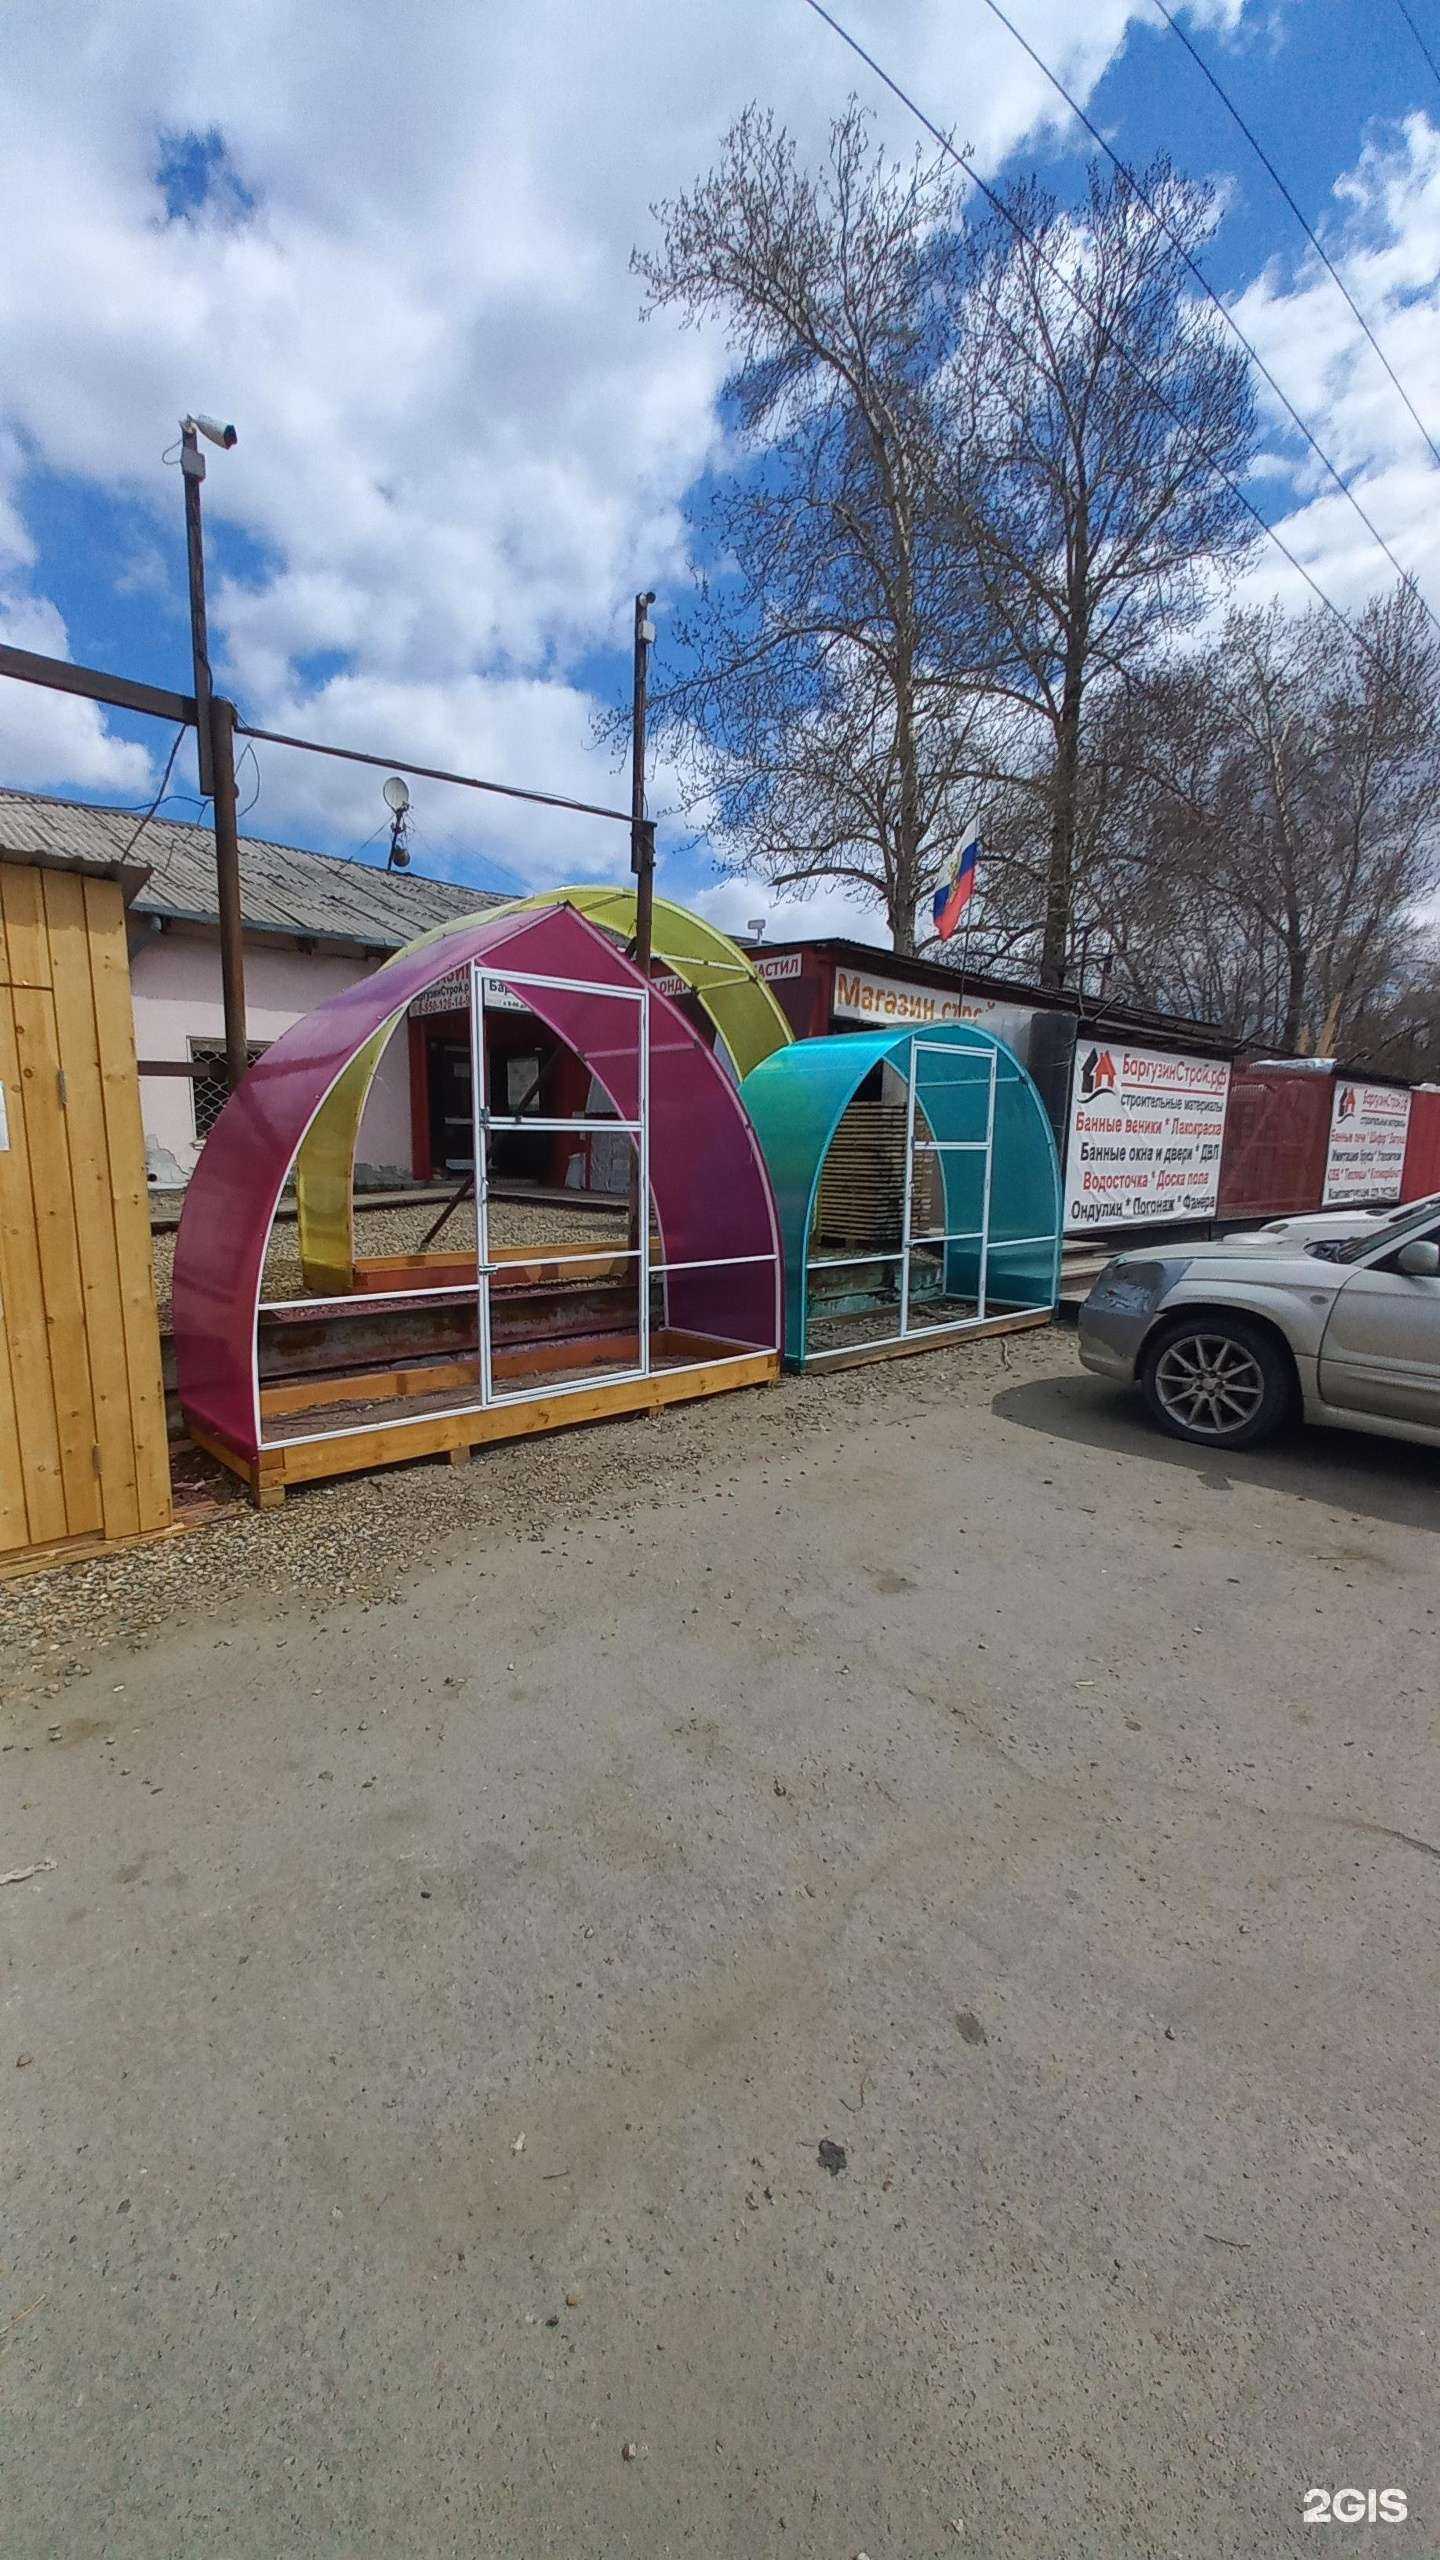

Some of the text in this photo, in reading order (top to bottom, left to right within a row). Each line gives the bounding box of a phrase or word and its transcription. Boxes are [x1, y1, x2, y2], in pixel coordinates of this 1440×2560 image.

[754, 958, 799, 977] АСТИЛ
[660, 979, 686, 994] ОНД
[838, 973, 935, 1020] Магазин
[1122, 1053, 1227, 1090] БаргузинСтрой.рф
[1120, 1093, 1183, 1110] строительные
[1076, 1112, 1222, 1138] Банные веники Лакокраска
[1080, 1142, 1126, 1161] Банные
[1129, 1146, 1154, 1161] окна
[1155, 1147, 1162, 1161] и
[1163, 1147, 1193, 1164] двери
[1083, 1170, 1209, 1193] Водосточка Доска пола
[1071, 1194, 1216, 1222] Ондулин Погонаж Фанера
